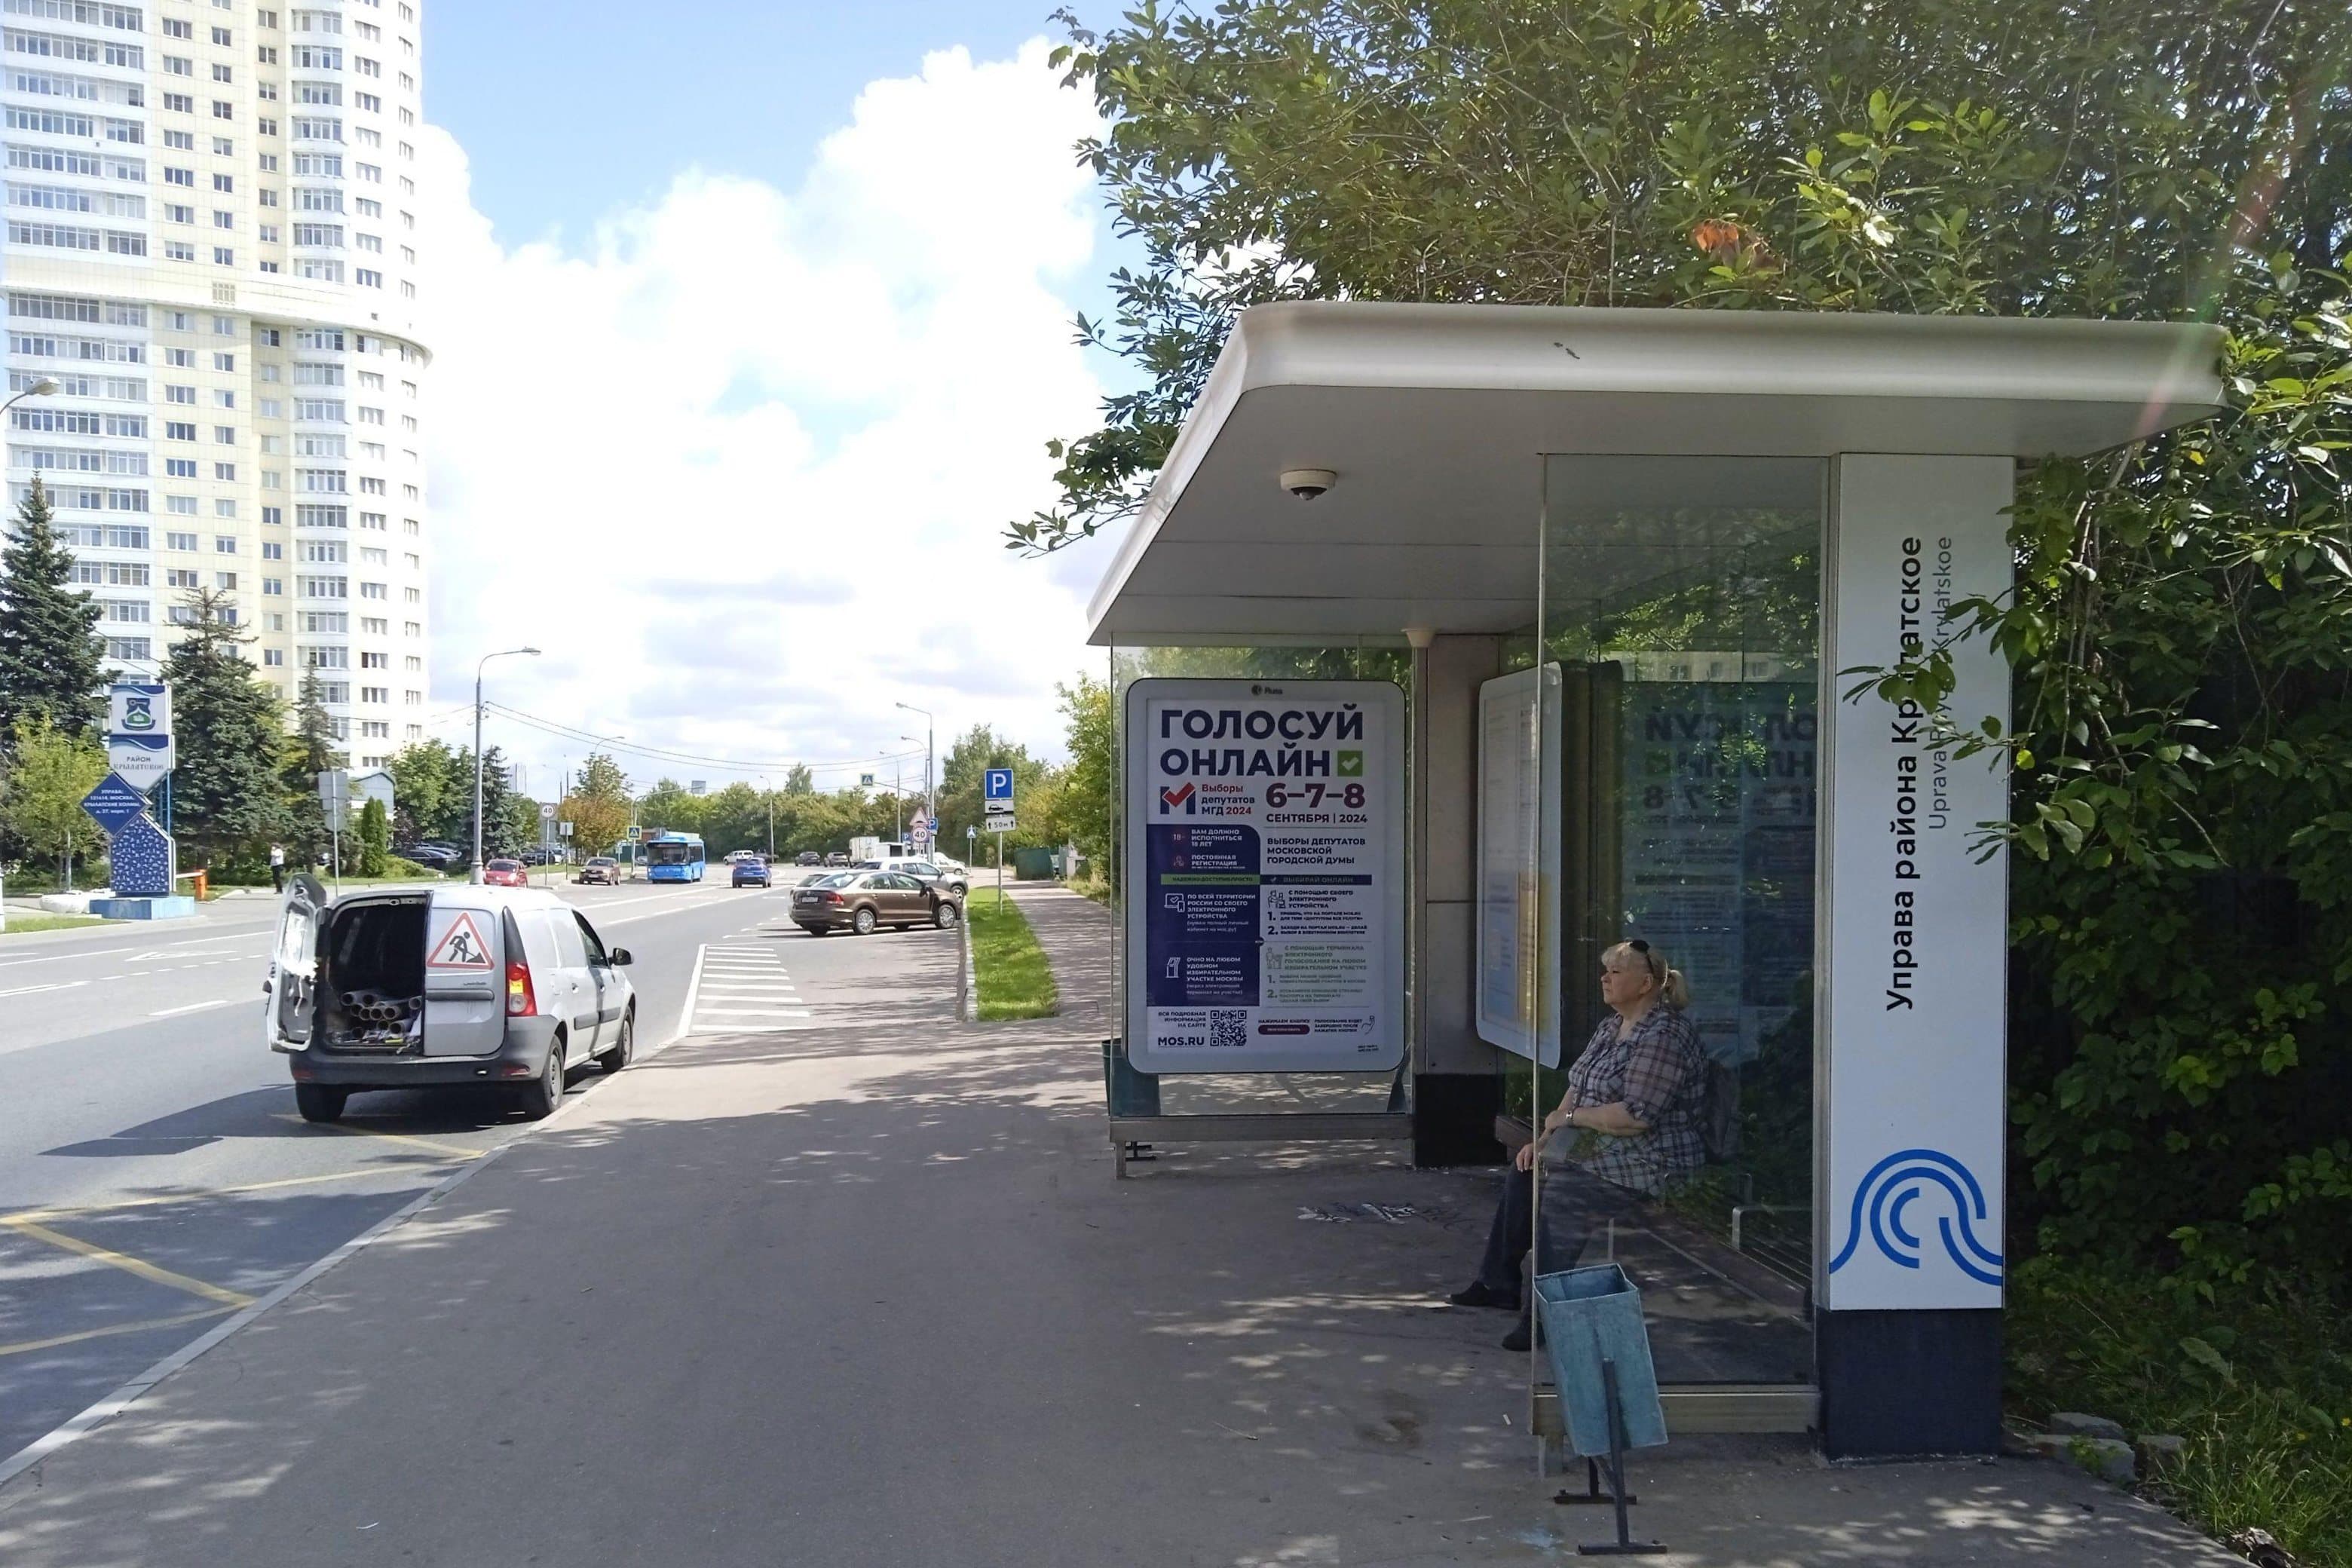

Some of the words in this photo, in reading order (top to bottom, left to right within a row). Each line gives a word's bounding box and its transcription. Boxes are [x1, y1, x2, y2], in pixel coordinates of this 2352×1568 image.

[1161, 703, 1363, 740] ГОЛОСУЙ
[1159, 743, 1330, 776] ОНЛАЙН
[992, 773, 1007, 795] P
[1202, 784, 1243, 794] Выборы
[1929, 751, 1951, 829] Uprava
[1202, 797, 1255, 805] депутатов
[1202, 807, 1223, 816] МГД
[1226, 807, 1251, 815] 2024
[1266, 813, 1329, 823] СЕНТЯБРЯ
[1339, 814, 1368, 823] 2024
[1890, 755, 1920, 879] района
[1267, 847, 1332, 855] МОСКОВСКОЙ
[1267, 856, 1323, 865] ГОРОДСКОЙ
[1325, 856, 1355, 865] ДУМЫ
[1267, 912, 1276, 920] 1.
[1268, 926, 1278, 935] 2.
[1886, 891, 1918, 1011] Управа
[1158, 1037, 1205, 1046] MOS.RU
